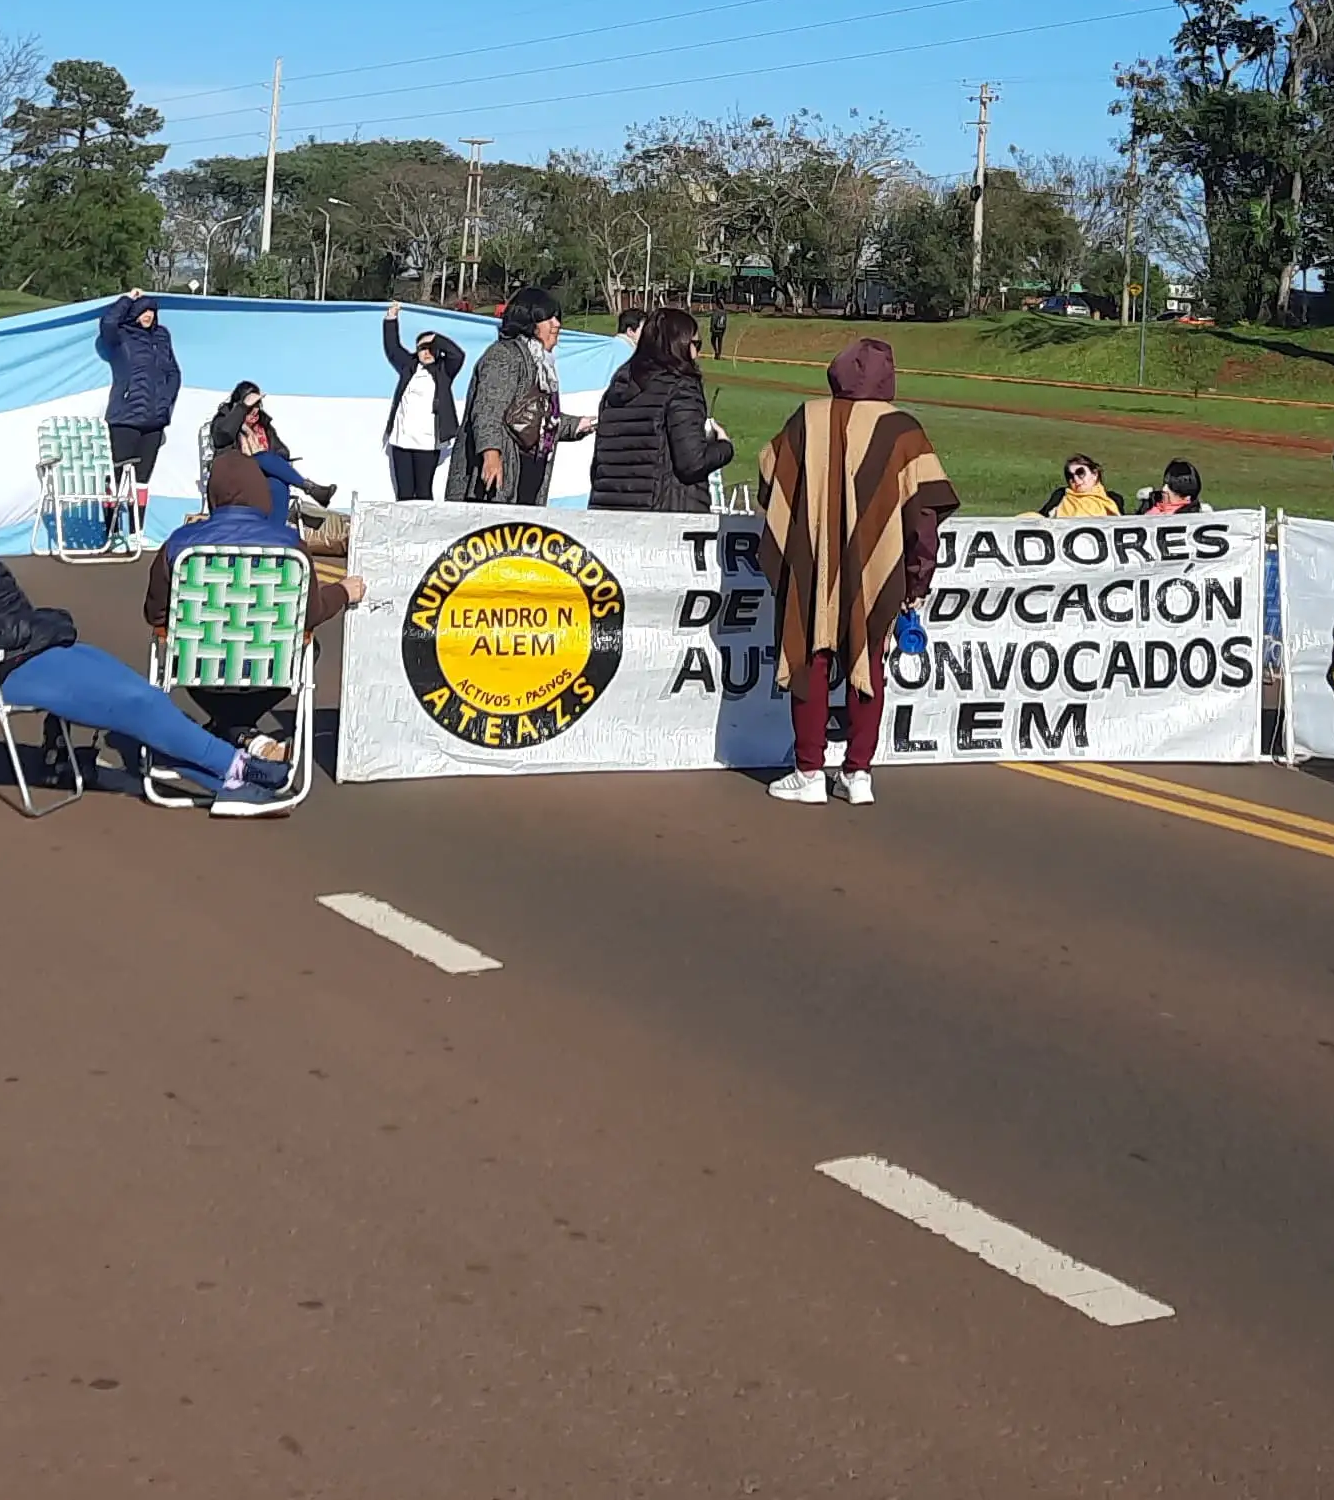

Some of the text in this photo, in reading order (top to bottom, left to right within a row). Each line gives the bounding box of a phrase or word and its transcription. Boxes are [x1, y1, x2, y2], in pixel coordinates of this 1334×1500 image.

[682, 524, 1230, 572] TRJADORES
[411, 526, 620, 631] AUTOCONVOCADOS
[679, 564, 1243, 627] DE DUCACIÓN
[450, 607, 579, 629] LEANDRO N.
[470, 634, 555, 656] ALEM
[457, 678, 510, 707] ACTIVOS
[526, 668, 572, 705] PASIVOS
